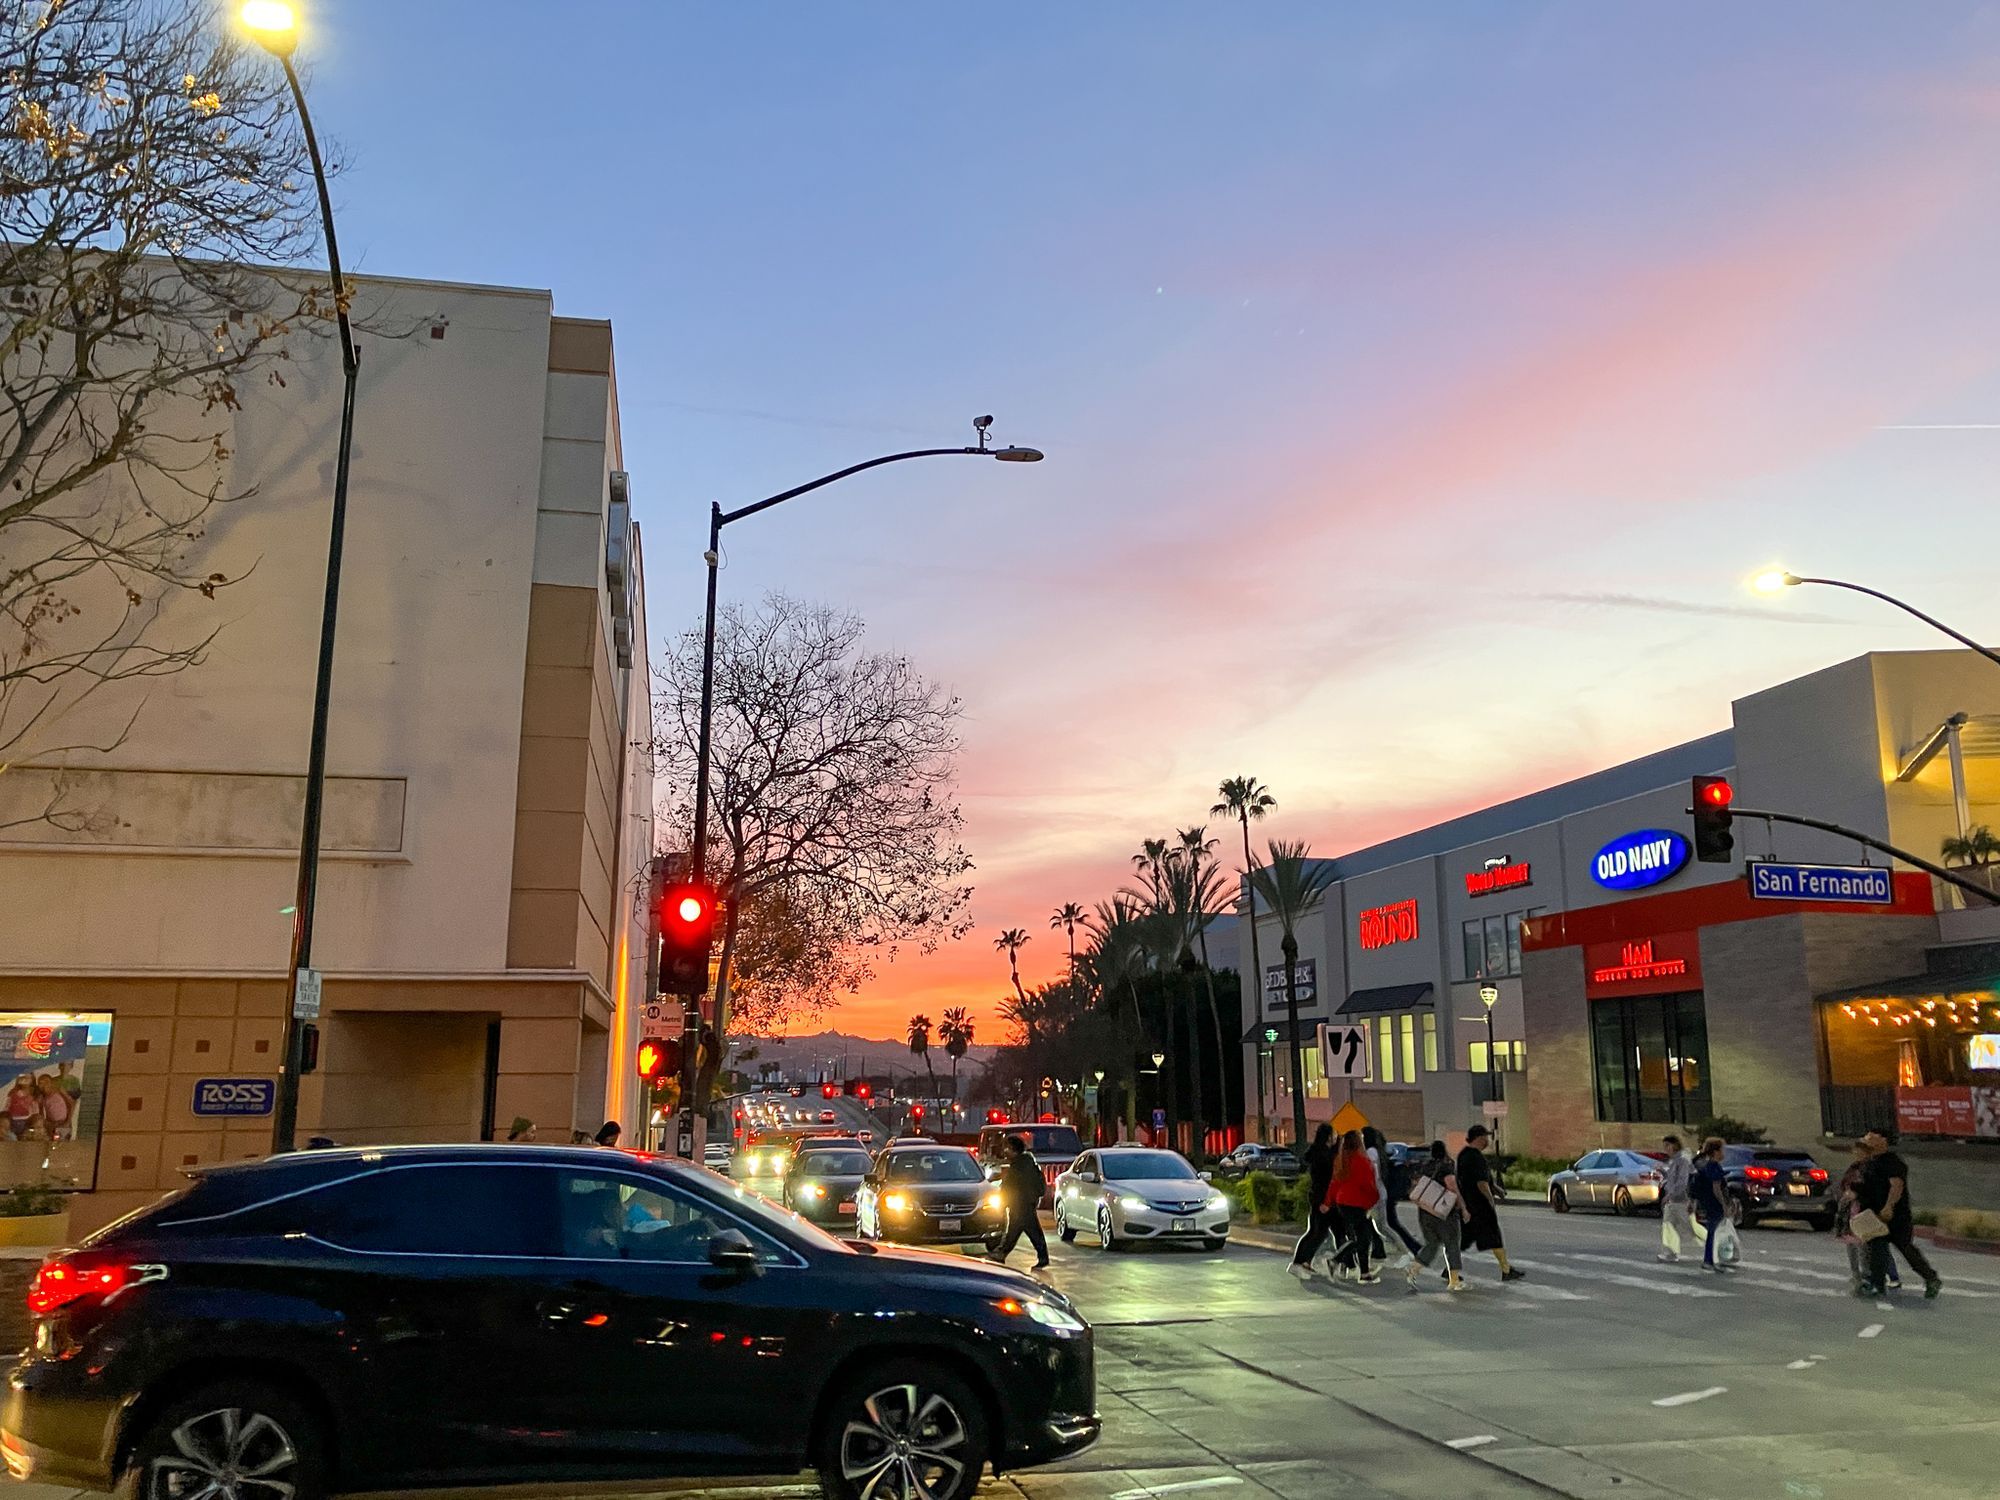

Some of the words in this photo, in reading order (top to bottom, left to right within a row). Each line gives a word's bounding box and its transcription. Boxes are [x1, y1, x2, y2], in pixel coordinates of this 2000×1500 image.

[1598, 851, 1627, 879] OLD
[1628, 838, 1671, 872] NAVY
[1465, 872, 1494, 894] WORLD
[1493, 863, 1528, 886] MARKET
[1758, 869, 1793, 892] San
[1798, 871, 1886, 896] Fernando
[1595, 971, 1627, 982] KOREAN
[1654, 963, 1685, 977] HOUSE
[202, 1083, 267, 1103] ROSS
